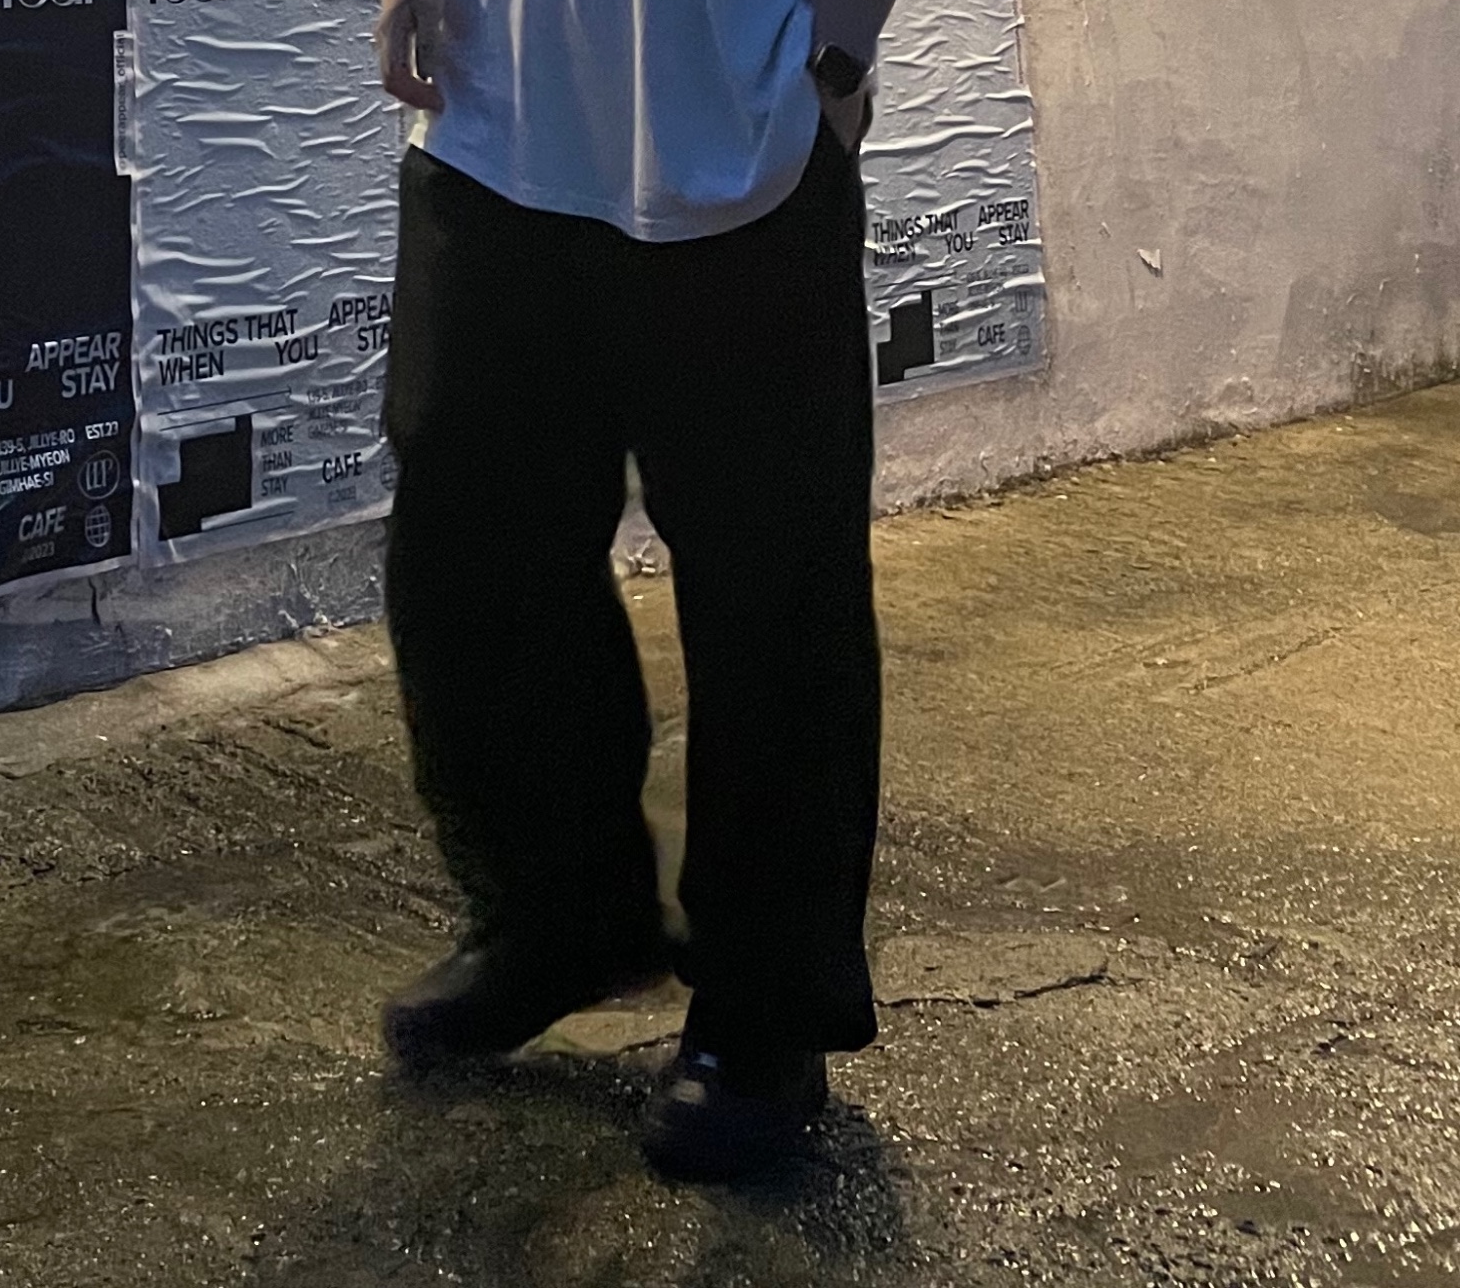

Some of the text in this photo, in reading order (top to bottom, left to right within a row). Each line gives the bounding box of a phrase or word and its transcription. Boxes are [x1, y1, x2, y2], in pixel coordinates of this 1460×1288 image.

[872, 199, 1029, 243] THINGS THAT APPEAR
[945, 232, 973, 254] YOU
[999, 222, 1030, 245] STAY
[157, 318, 239, 354] THINGS
[244, 309, 298, 341] THAT
[977, 323, 1006, 346] CAFE
[25, 332, 122, 372] APPEAR
[159, 324, 391, 385] WHEN YOU STA
[61, 361, 120, 399] STAY
[260, 425, 294, 448] MORE
[261, 450, 292, 472] THAN
[322, 452, 363, 484] CAFE
[261, 475, 289, 496] STAY
[18, 505, 68, 542] CAFE
